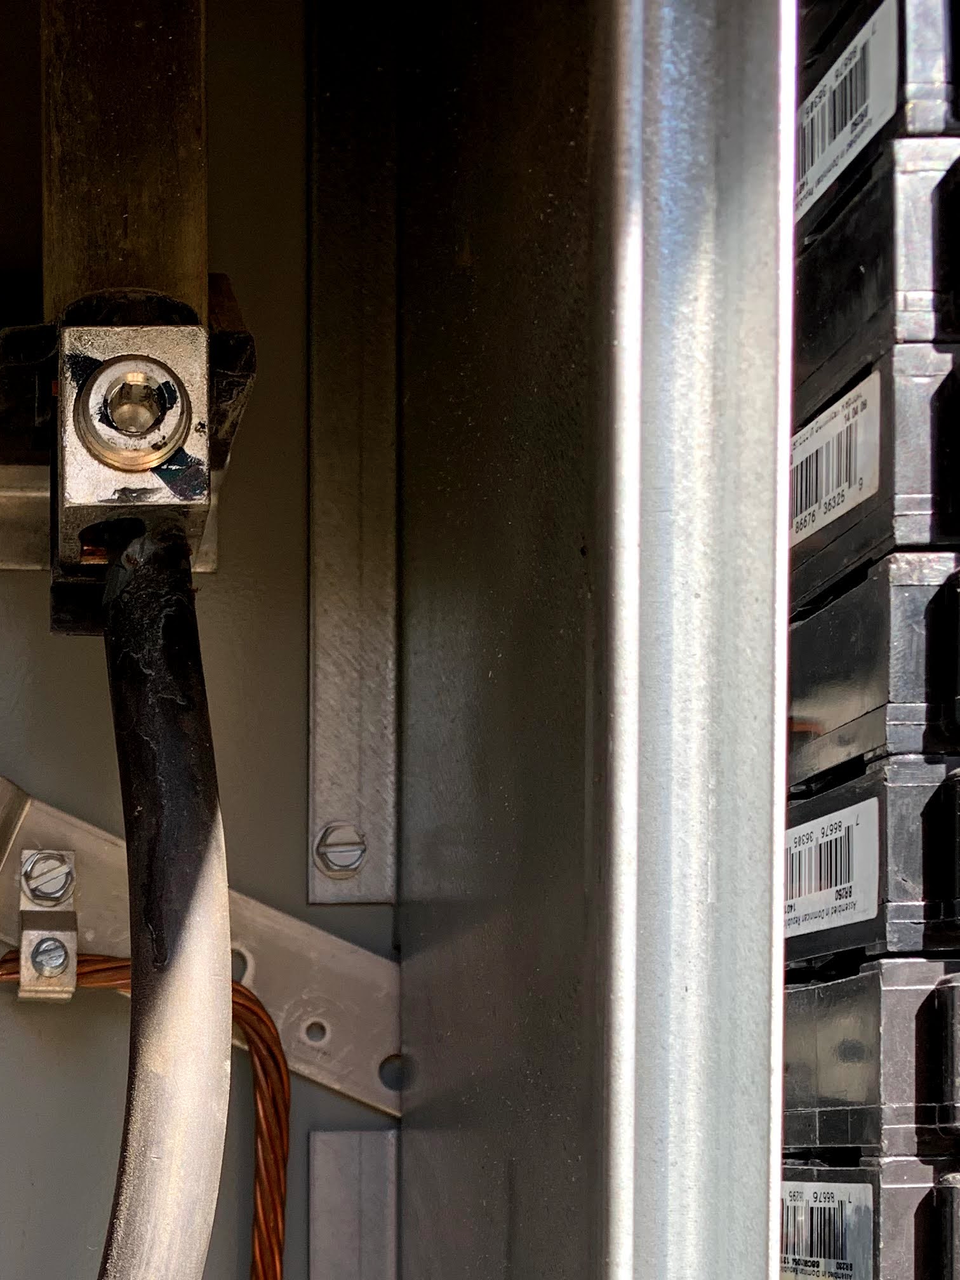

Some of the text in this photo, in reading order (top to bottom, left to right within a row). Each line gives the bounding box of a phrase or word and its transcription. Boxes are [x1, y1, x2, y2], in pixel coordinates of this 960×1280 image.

[795, 477, 863, 535] 86676 36325 9
[855, 813, 860, 826] 7
[820, 820, 842, 838] 86676
[812, 1192, 834, 1202] 86676
[847, 1193, 852, 1203] 7
